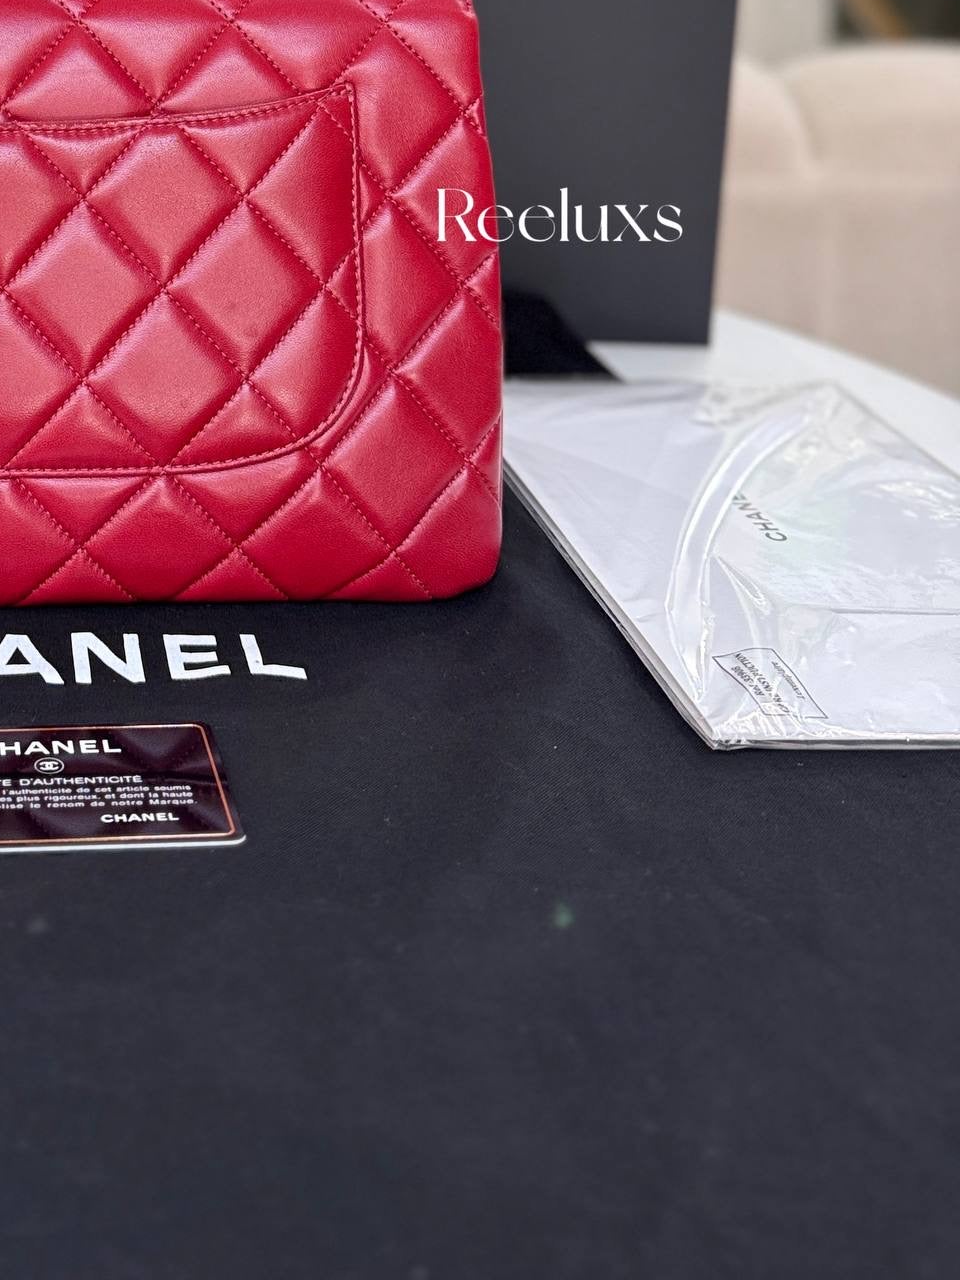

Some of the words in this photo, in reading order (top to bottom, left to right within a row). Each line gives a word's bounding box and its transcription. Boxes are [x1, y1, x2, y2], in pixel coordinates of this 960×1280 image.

[19, 775, 143, 787] D'AUTHENTICITÉ
[116, 785, 150, 793] article
[16, 795, 40, 804] plus
[111, 799, 143, 807] notre
[100, 812, 180, 823] CHANEL
